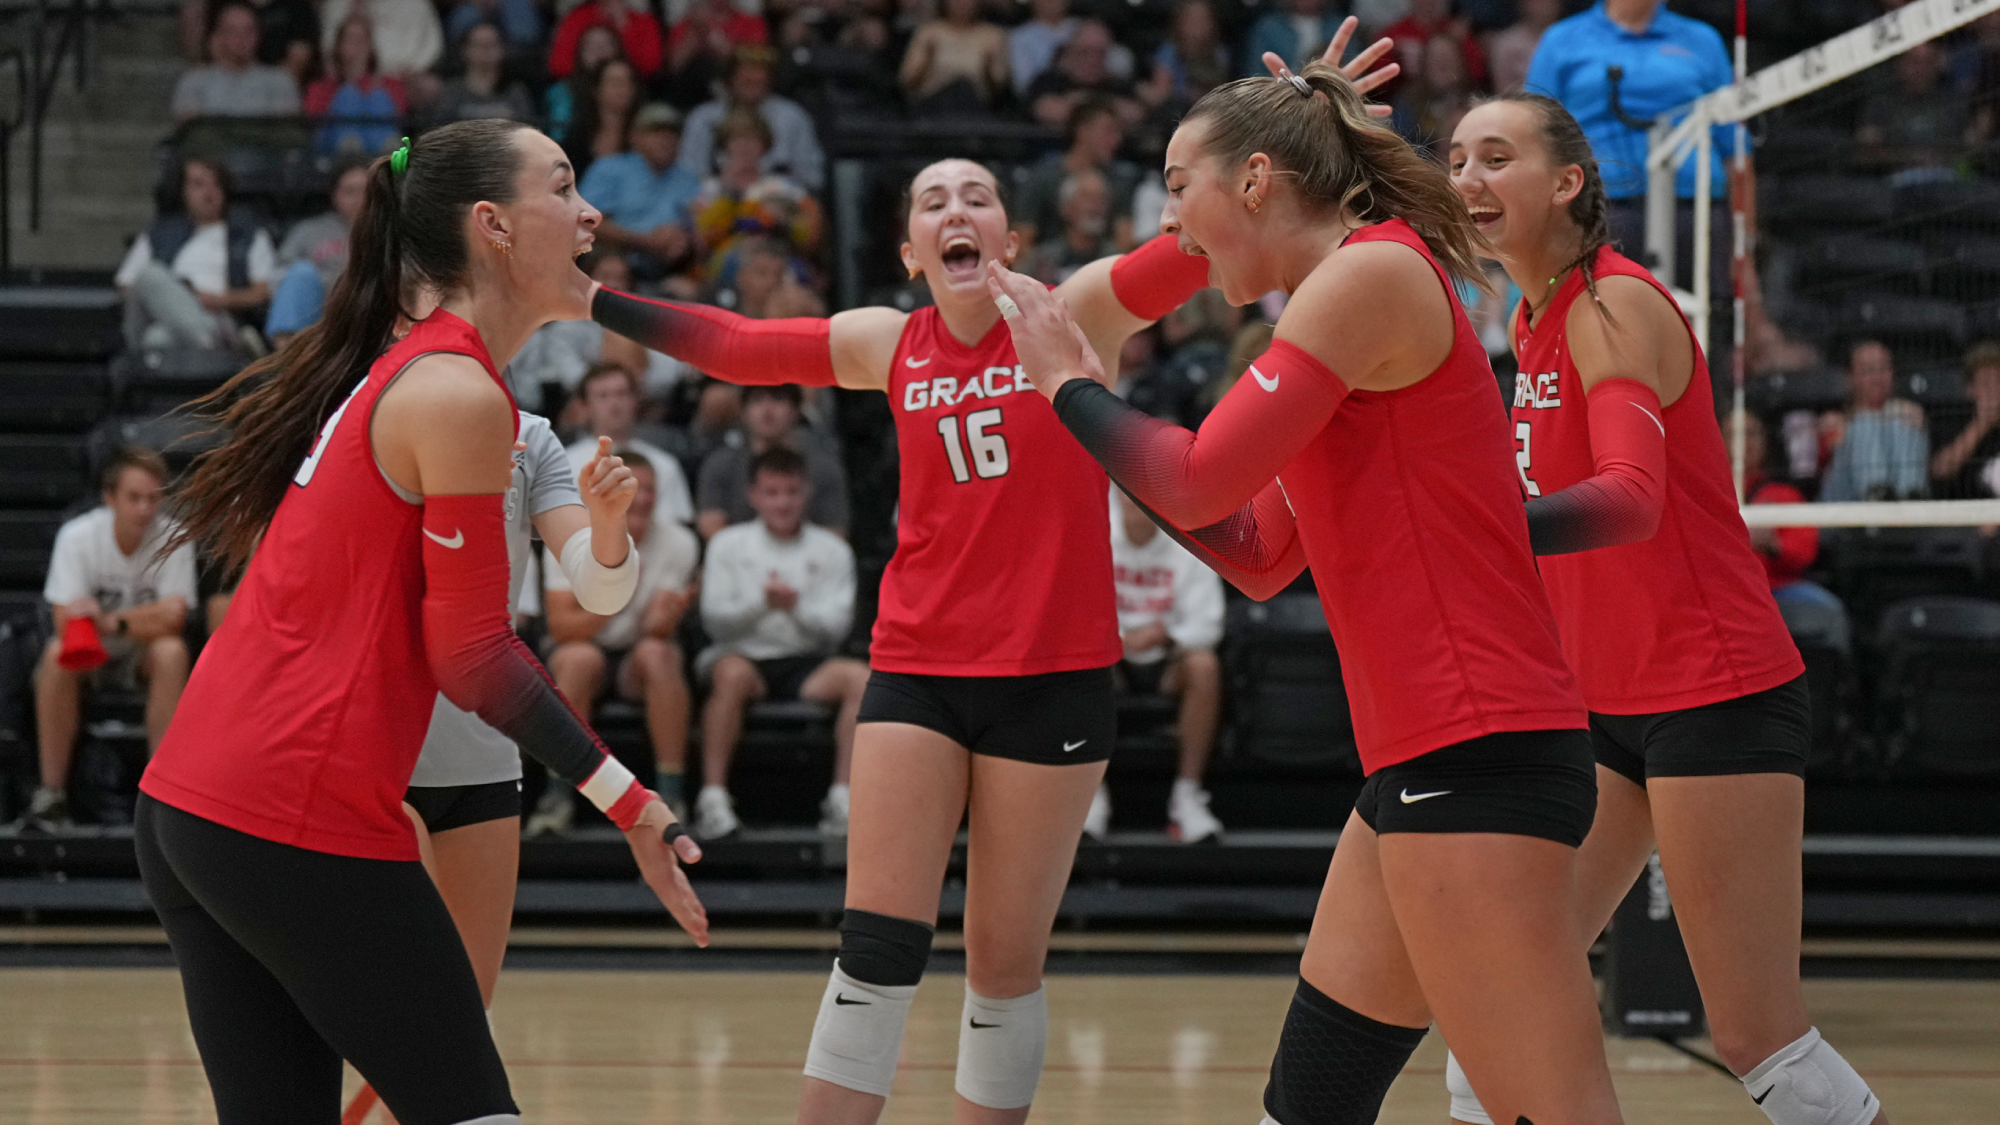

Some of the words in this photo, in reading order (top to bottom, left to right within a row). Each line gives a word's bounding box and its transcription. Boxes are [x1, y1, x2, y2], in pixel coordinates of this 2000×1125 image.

[904, 364, 1037, 412] GRACE
[1513, 370, 1561, 409] RACE
[937, 406, 1010, 484] 16
[1515, 421, 1541, 497] 2
